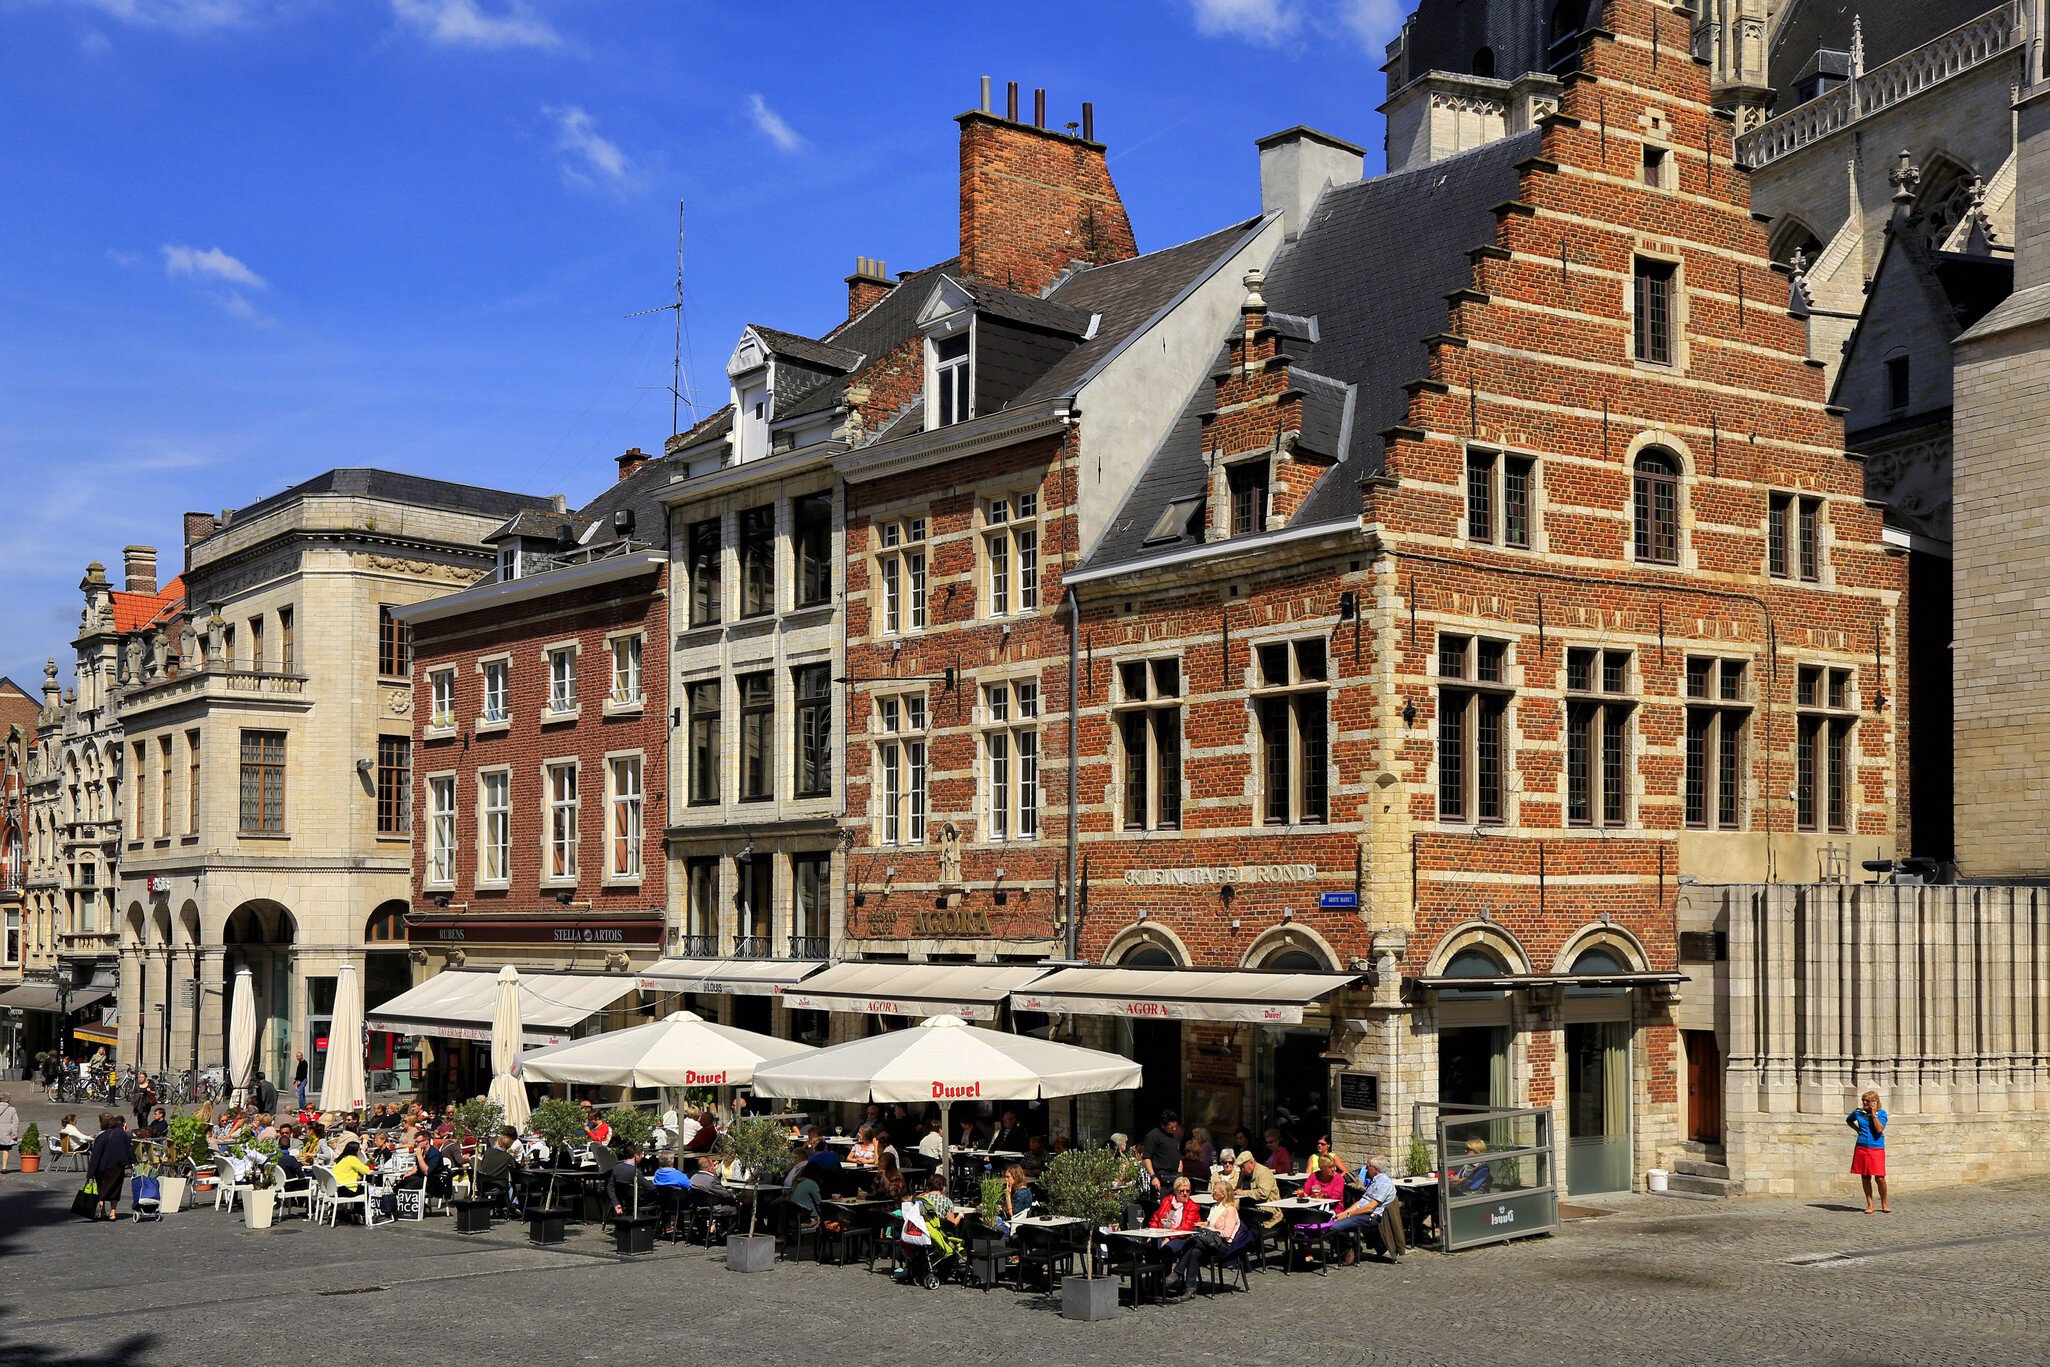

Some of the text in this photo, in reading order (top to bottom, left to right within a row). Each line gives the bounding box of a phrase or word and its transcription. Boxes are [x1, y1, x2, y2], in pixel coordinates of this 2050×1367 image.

[1130, 869, 1183, 886] KLEIN
[1193, 867, 1245, 884] TAFEL
[911, 910, 991, 935] AGORA
[439, 929, 465, 940] RUBENS
[553, 929, 623, 942] STELLA ARTOIS
[866, 1001, 899, 1013] AGORA
[1125, 1003, 1168, 1016] AGORA
[1264, 1010, 1282, 1019] Duvel
[685, 1069, 727, 1084] Duvel
[931, 1080, 980, 1098] Duvel
